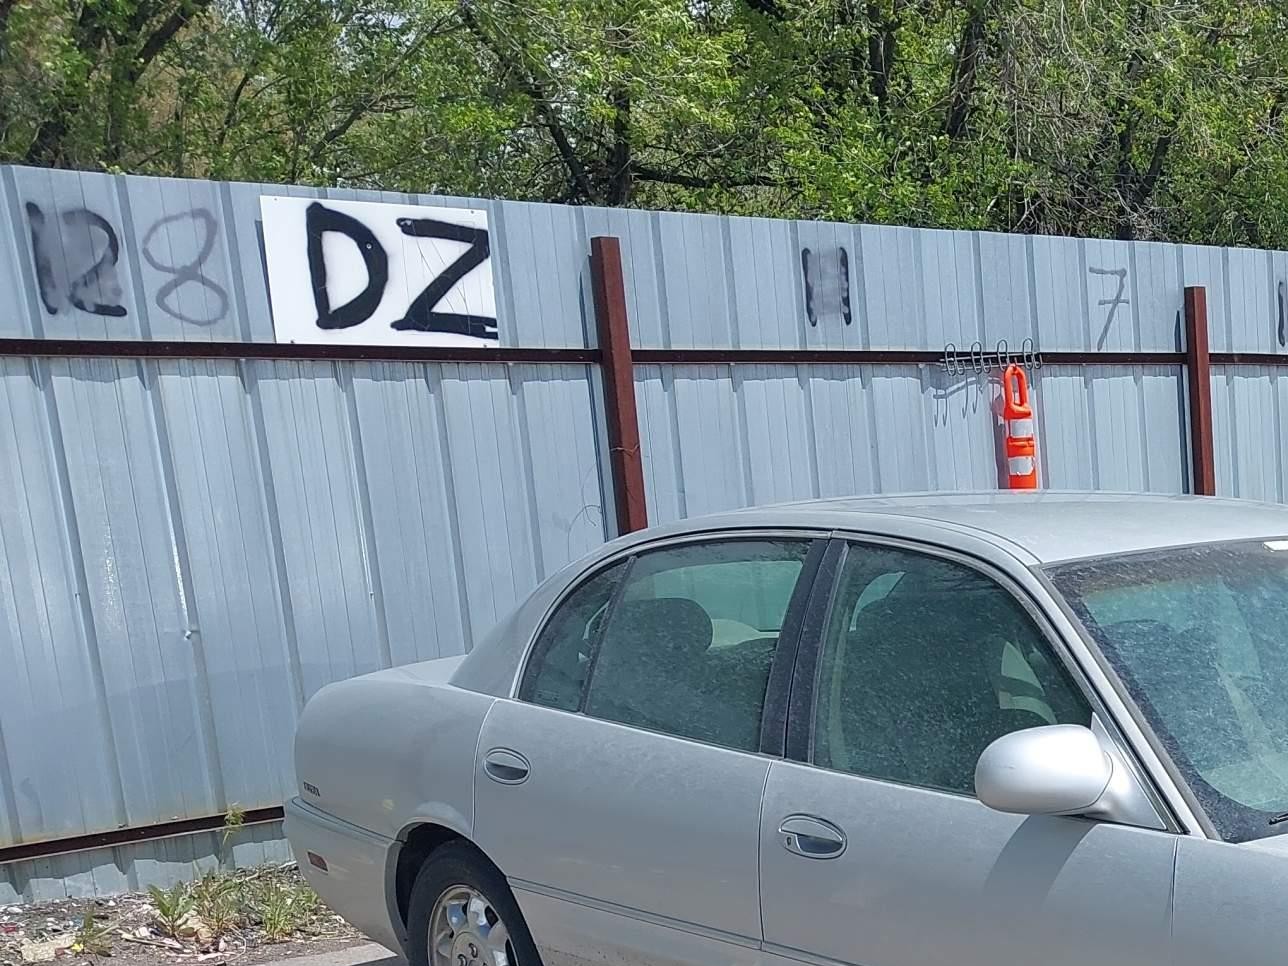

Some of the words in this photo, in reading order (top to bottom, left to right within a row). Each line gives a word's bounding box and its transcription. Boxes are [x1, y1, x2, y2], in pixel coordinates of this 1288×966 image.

[142, 208, 229, 326] 8
[305, 202, 498, 340] DZ
[1089, 266, 1129, 351] 7
